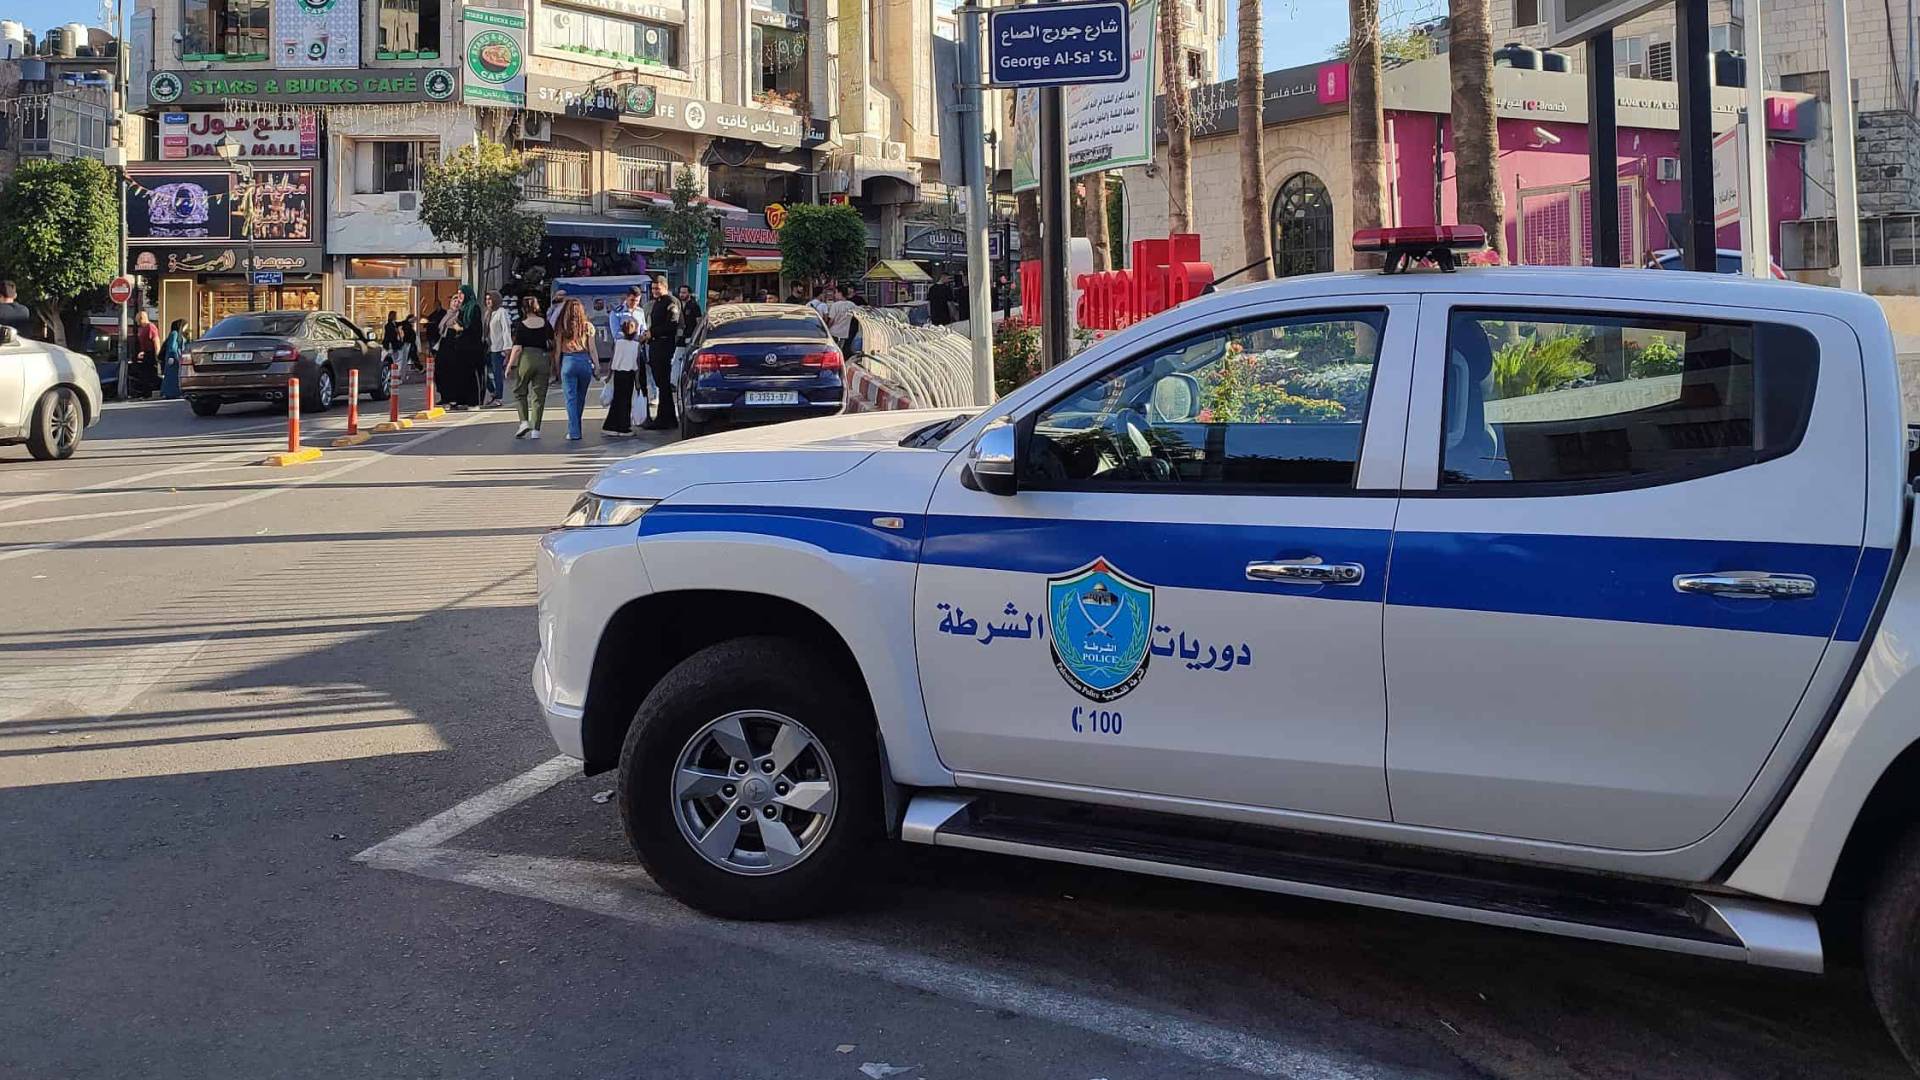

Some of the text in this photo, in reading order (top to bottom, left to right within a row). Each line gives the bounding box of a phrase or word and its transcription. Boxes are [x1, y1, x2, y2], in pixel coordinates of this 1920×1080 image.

[1001, 25, 1040, 46] الصاع
[1042, 25, 1081, 43] جورج
[1084, 19, 1119, 41] شارع
[1000, 56, 1050, 69] George
[1054, 51, 1094, 65] Al-Sa'
[1098, 50, 1117, 62] St.
[190, 72, 417, 94] STARS & BUCKS CAFÉ
[190, 113, 250, 136] مول
[251, 143, 298, 156] MALL
[936, 602, 1251, 671] دوريات الشرطة
[1083, 640, 1116, 653] الشرطة
[1083, 654, 1119, 664] POLICE
[1089, 710, 1122, 734] 100
